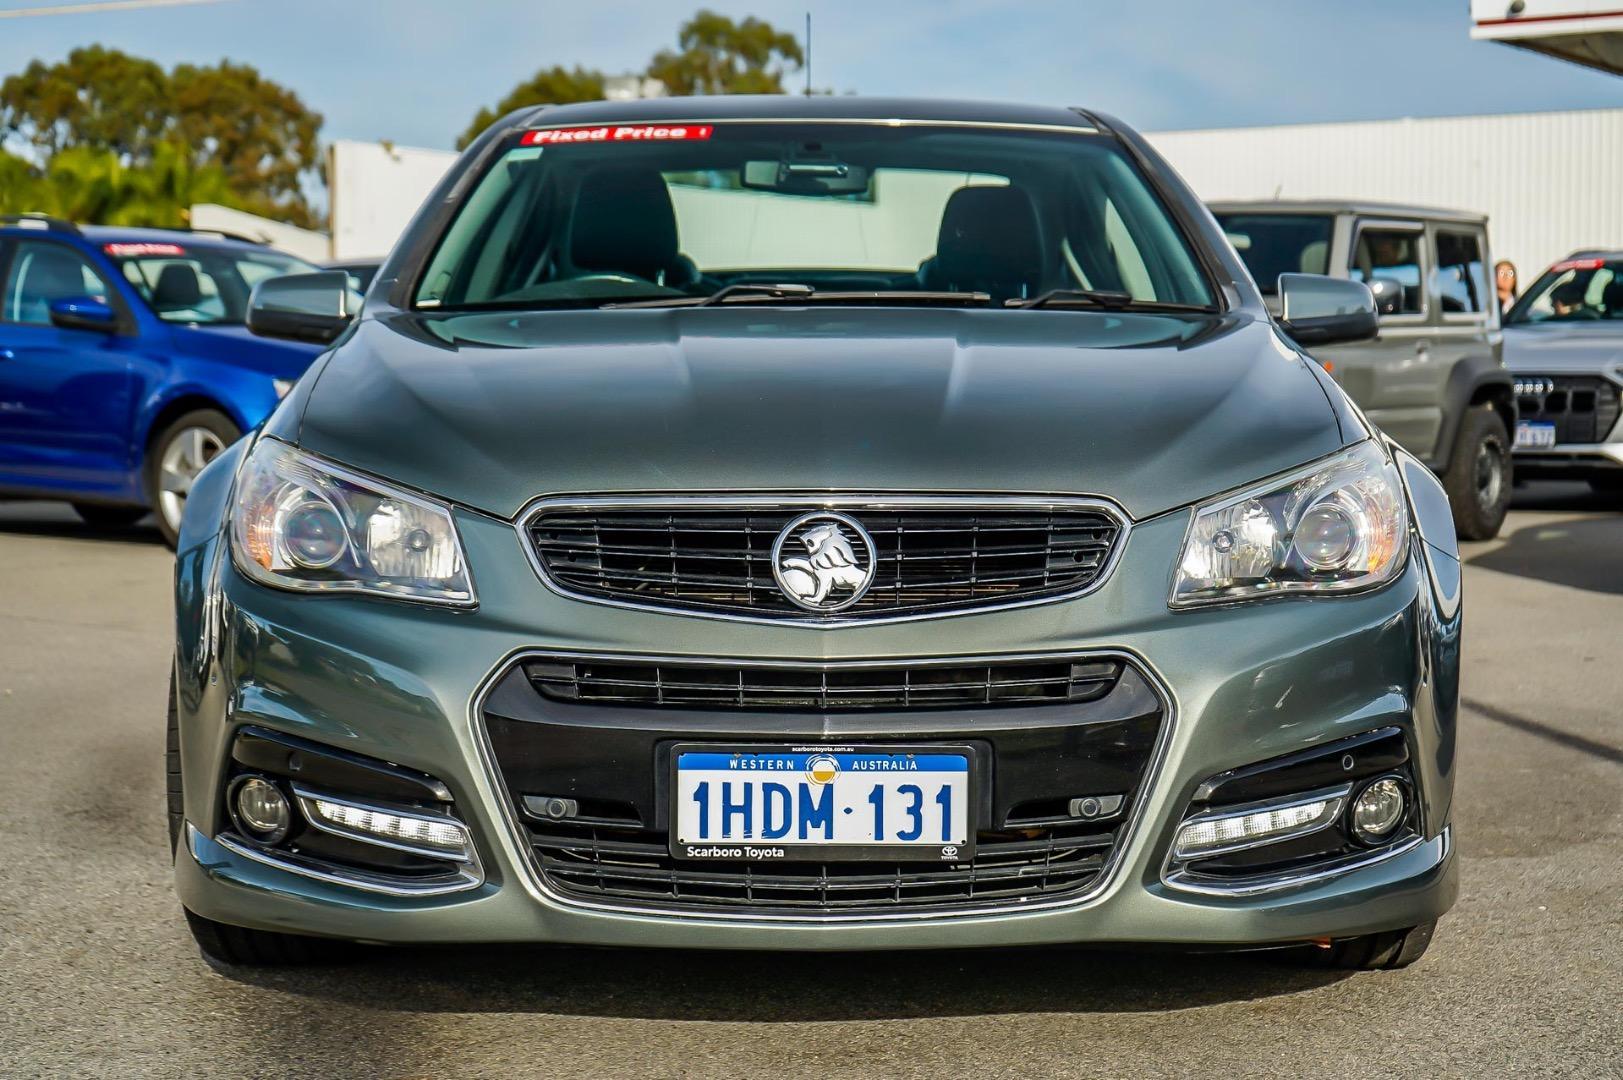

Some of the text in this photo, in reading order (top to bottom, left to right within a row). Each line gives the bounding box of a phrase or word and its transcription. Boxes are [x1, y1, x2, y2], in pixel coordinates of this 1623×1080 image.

[532, 126, 687, 143] Fixed Price
[730, 759, 795, 770] WESTERN
[852, 761, 918, 770] AUSTRALIA
[687, 846, 784, 859] Scarboro Toyota
